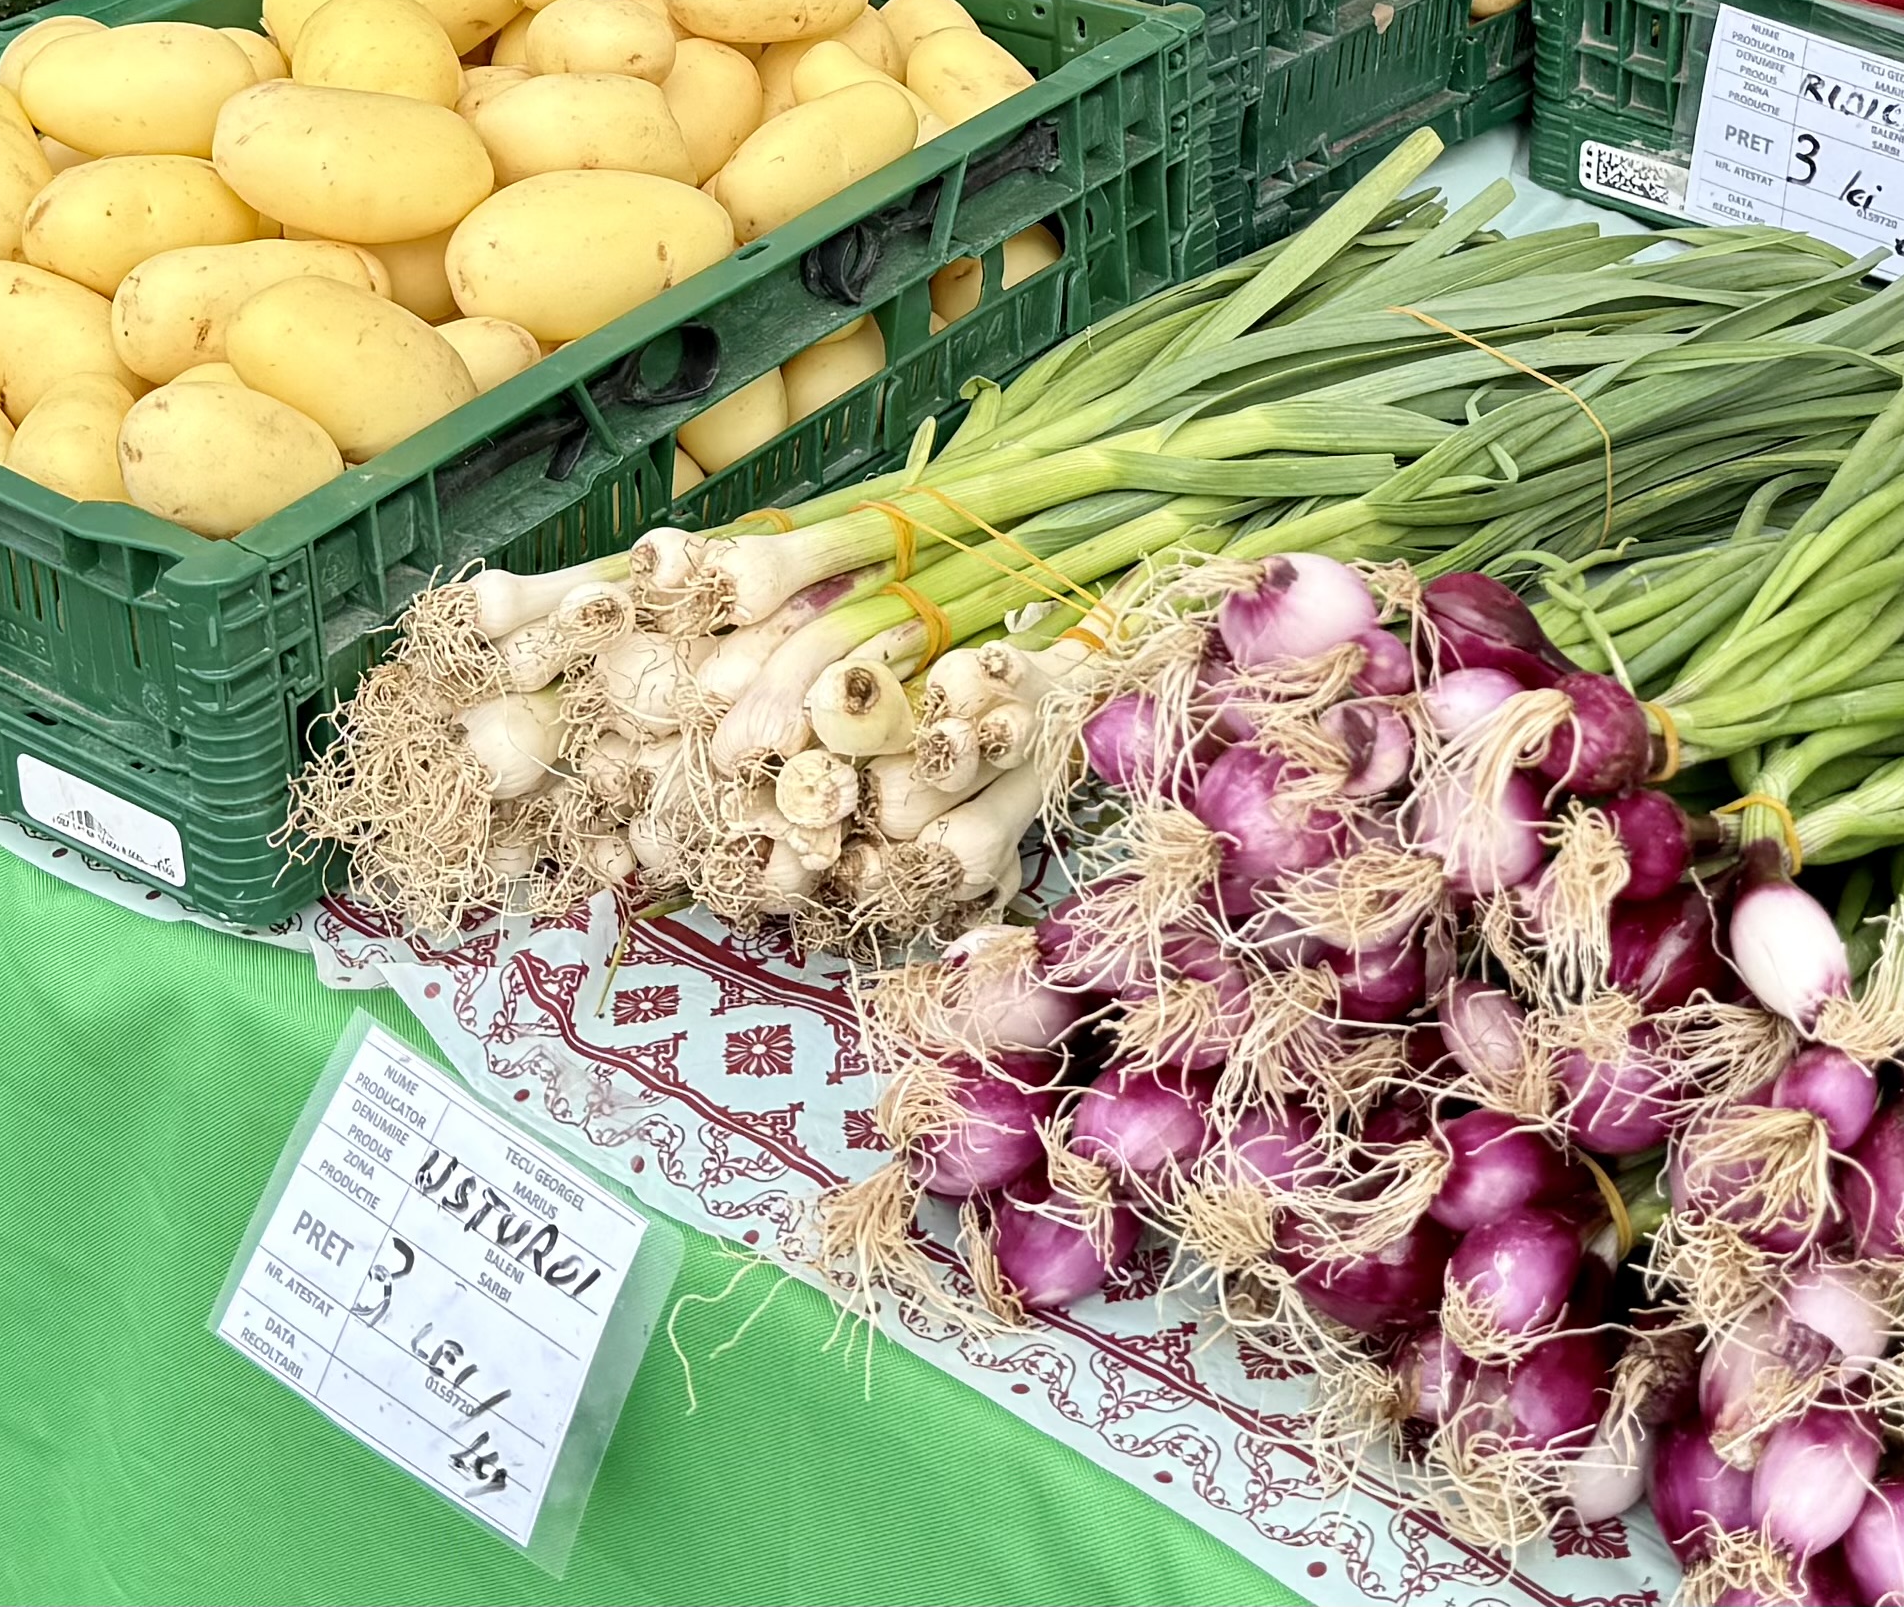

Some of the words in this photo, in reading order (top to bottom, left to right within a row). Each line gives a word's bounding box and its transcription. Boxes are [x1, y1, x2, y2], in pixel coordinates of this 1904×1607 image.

[1751, 23, 1780, 41] NUME
[1725, 124, 1774, 155] PRET
[1786, 133, 1820, 186] 3
[1734, 164, 1774, 187] ATESTAT
[1728, 193, 1754, 210] DATA
[383, 1064, 420, 1097] NUME
[355, 1071, 427, 1131] PRODUCATOR
[351, 1099, 410, 1147] DENUMIRE
[347, 1124, 394, 1163] PRODUS
[318, 1158, 382, 1211] PRODUCTIE
[343, 1149, 376, 1181] ZONA
[505, 1146, 537, 1176] TECU
[533, 1163, 586, 1212] GEORGEL
[512, 1179, 559, 1220] MARIUS
[292, 1210, 355, 1268] PRET
[350, 1236, 415, 1328] 3
[484, 1248, 525, 1286] BALENI
[476, 1271, 514, 1304] SARBI
[264, 1317, 297, 1349] DATA
[264, 1261, 287, 1284] NR.
[282, 1270, 335, 1318] ATESTAT
[425, 1376, 476, 1417] 0159720
[240, 1327, 305, 1380] RECOLTARII
